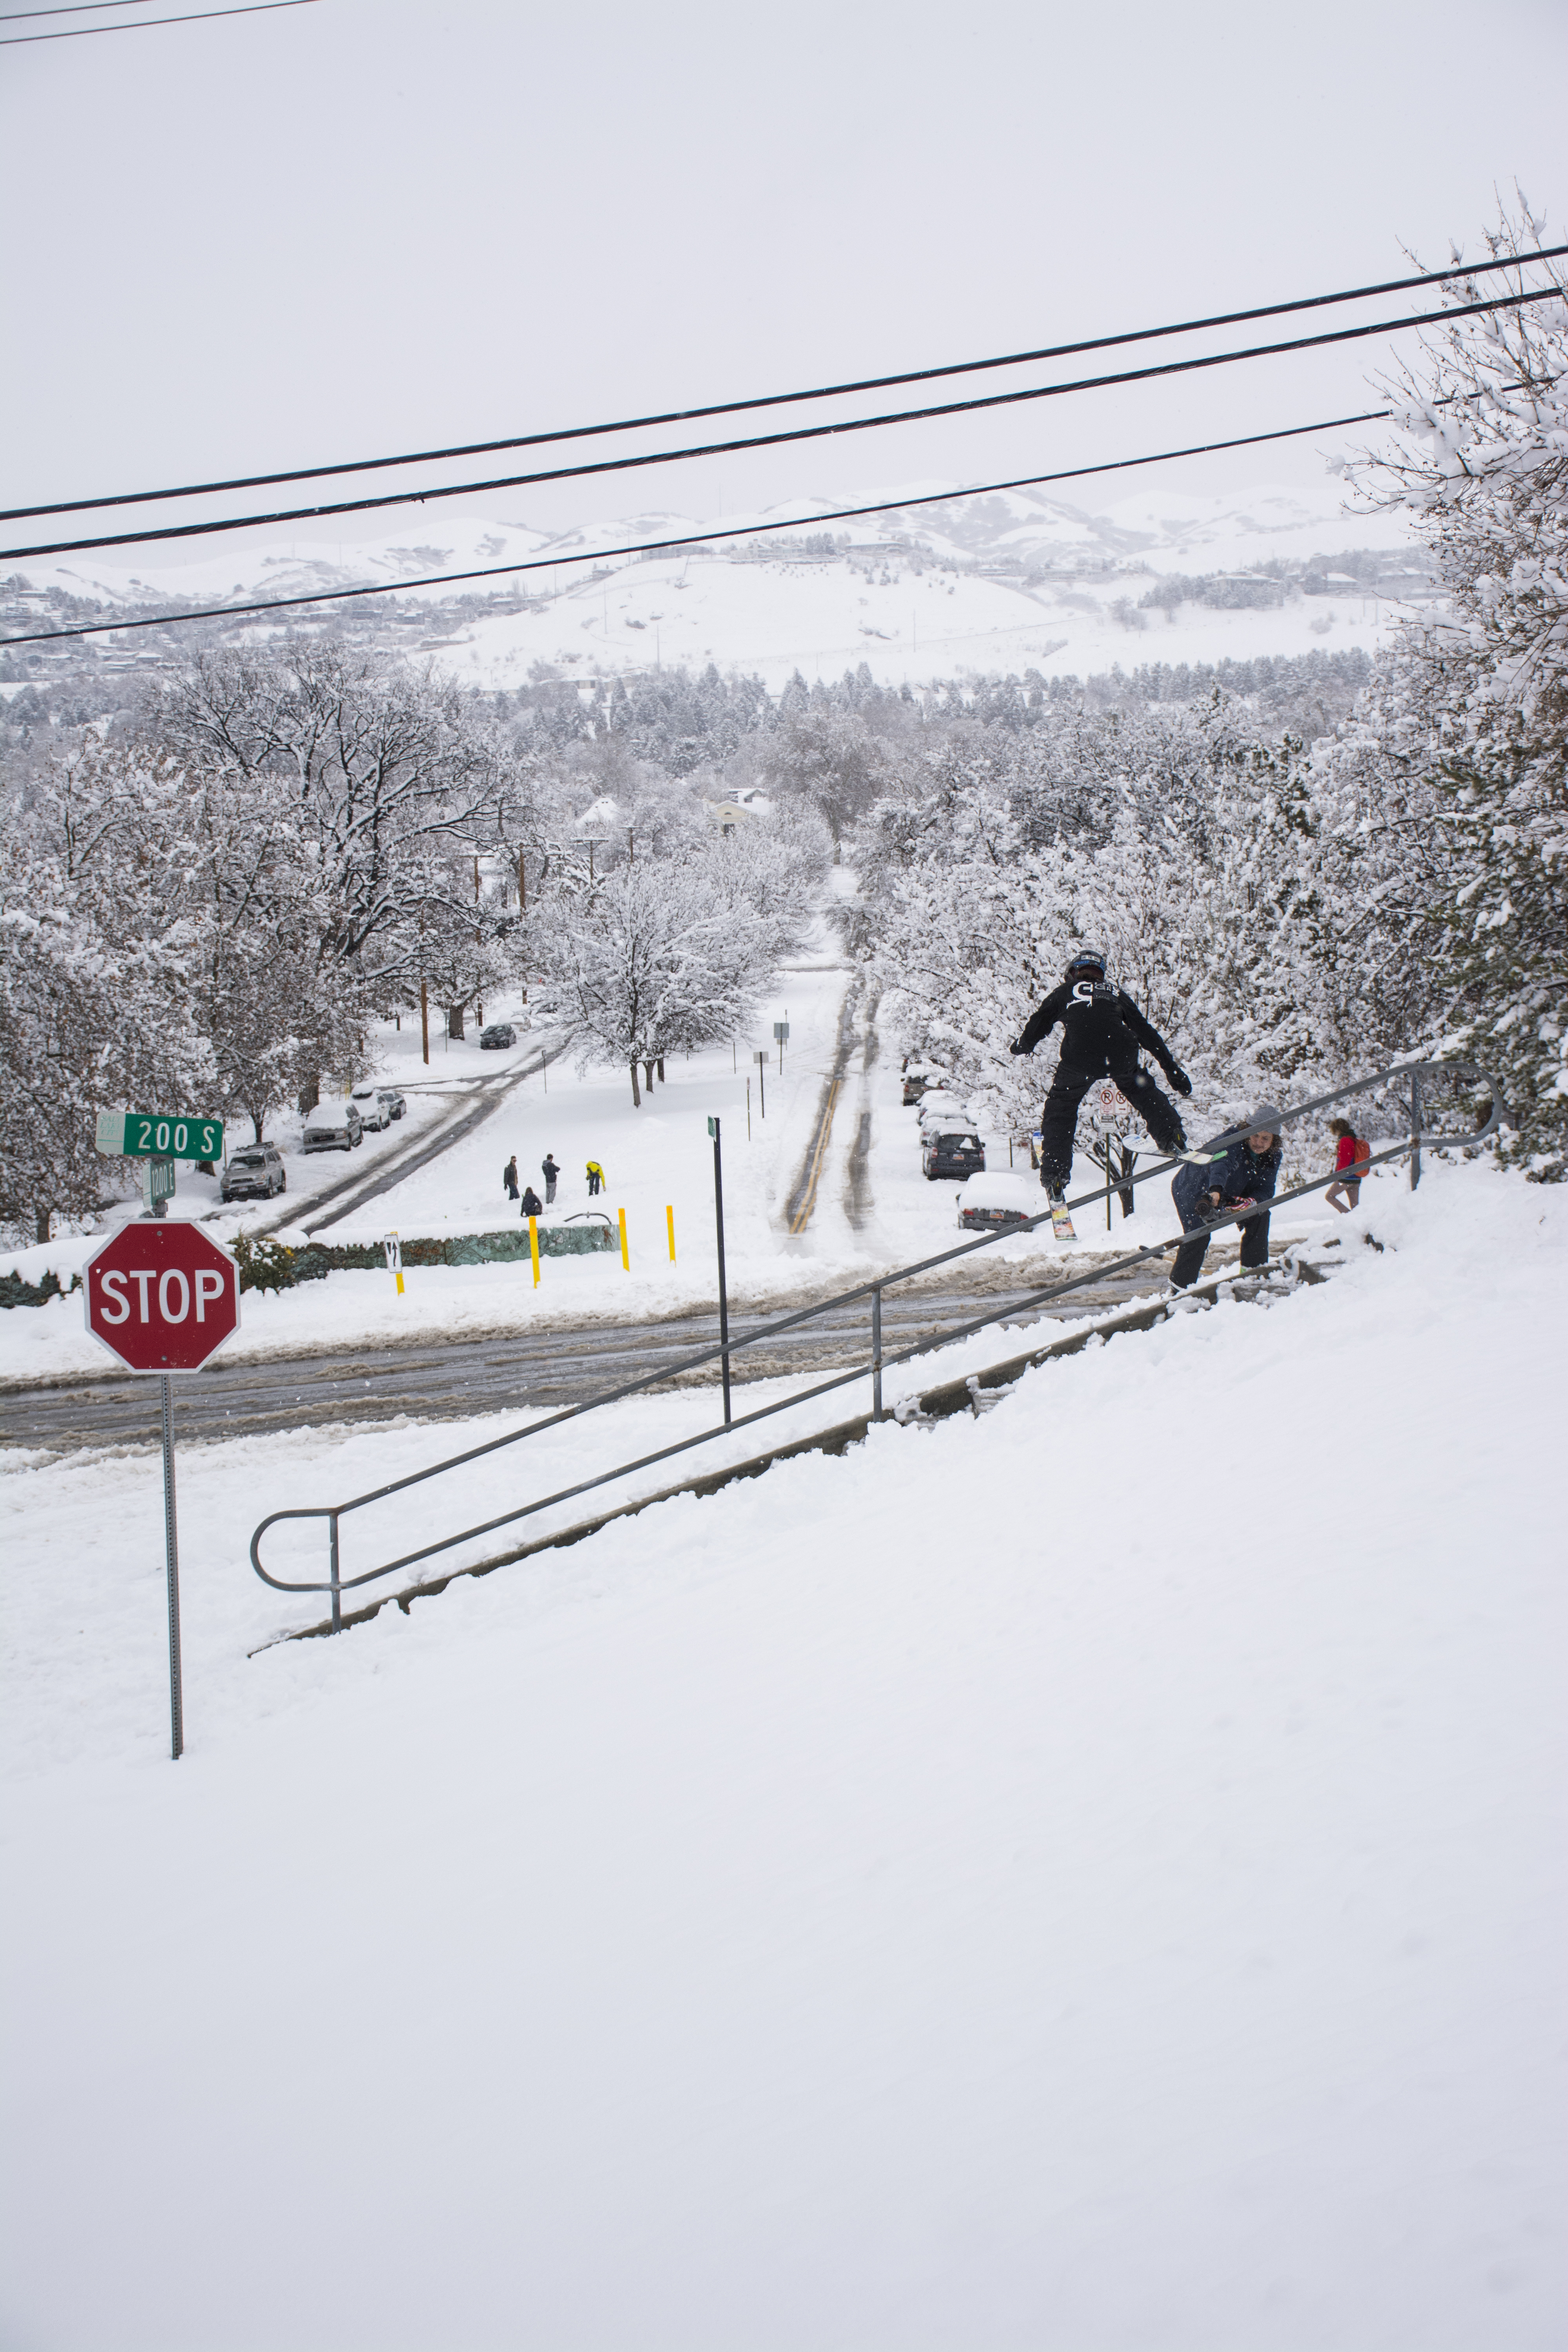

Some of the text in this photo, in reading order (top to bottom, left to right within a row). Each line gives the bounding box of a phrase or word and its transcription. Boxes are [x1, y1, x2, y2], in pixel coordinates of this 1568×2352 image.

[138, 1121, 215, 1153] 200 S
[152, 1165, 168, 1197] 1200
[169, 1163, 174, 1190] E
[100, 1269, 225, 1324] STOP
